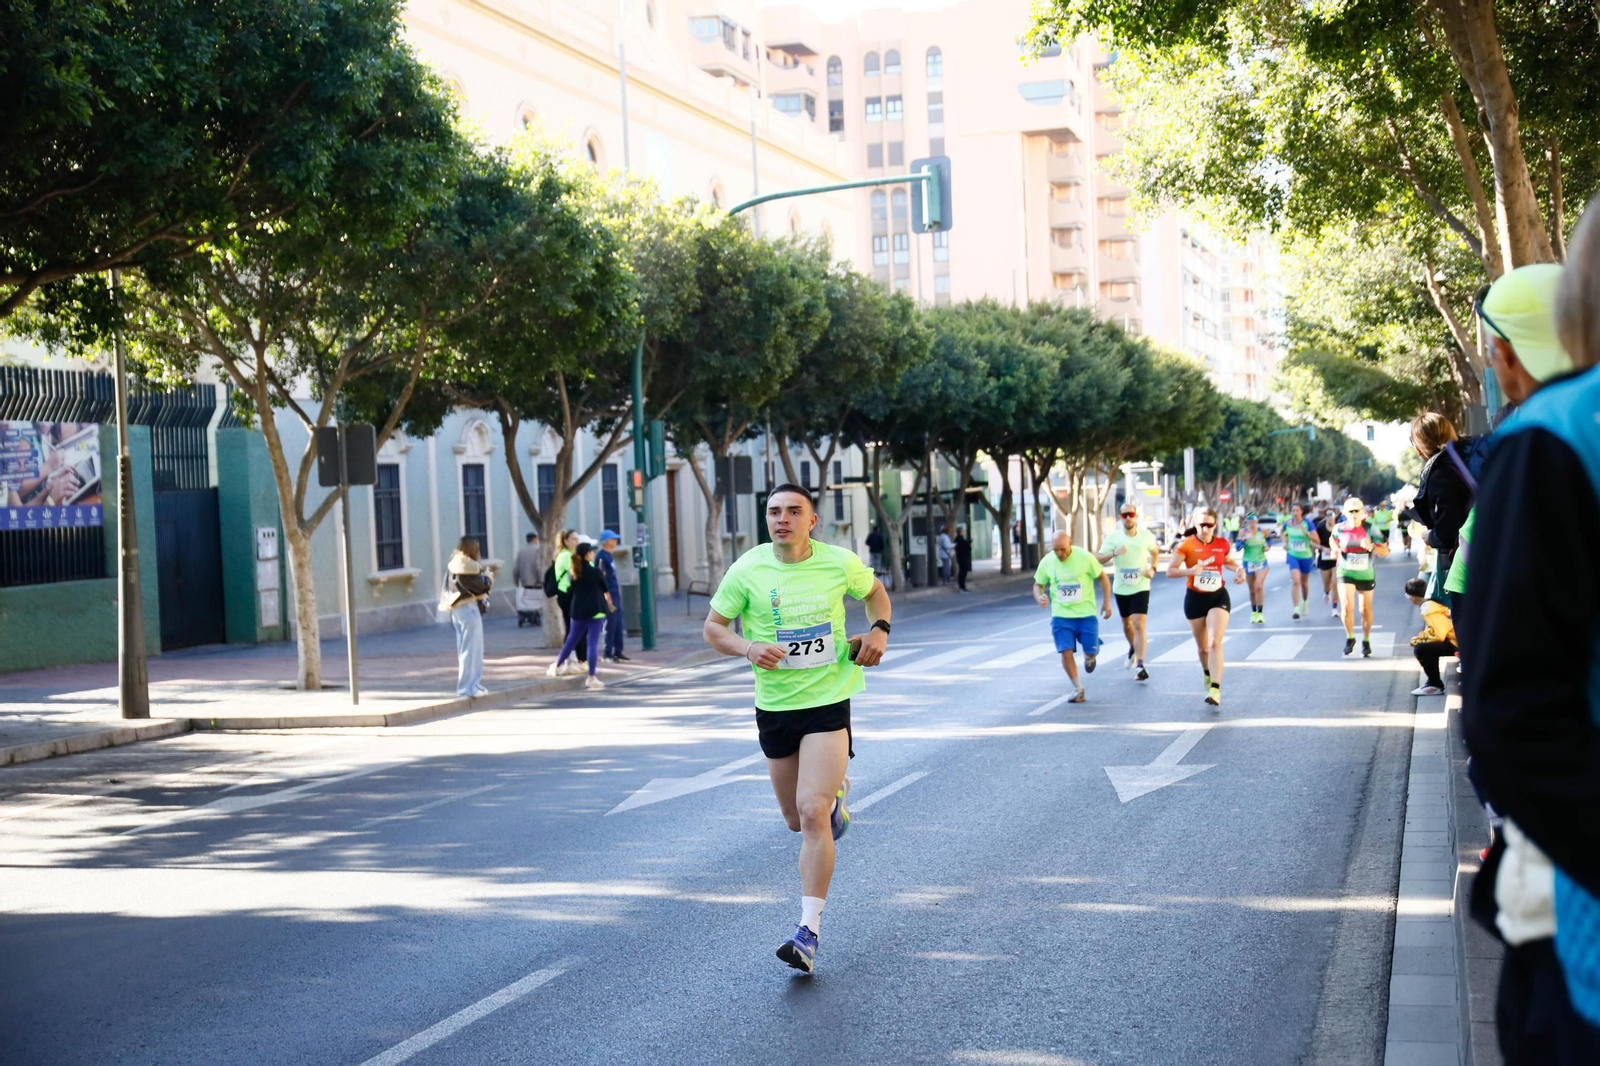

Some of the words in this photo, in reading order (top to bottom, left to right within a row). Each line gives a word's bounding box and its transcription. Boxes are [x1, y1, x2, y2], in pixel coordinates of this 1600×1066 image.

[1199, 576, 1217, 584] 672
[780, 597, 793, 606] En
[794, 593, 828, 604] marcha
[782, 603, 817, 615] contra
[819, 600, 828, 610] el
[784, 612, 827, 625] cáncer
[789, 639, 825, 656] 273
